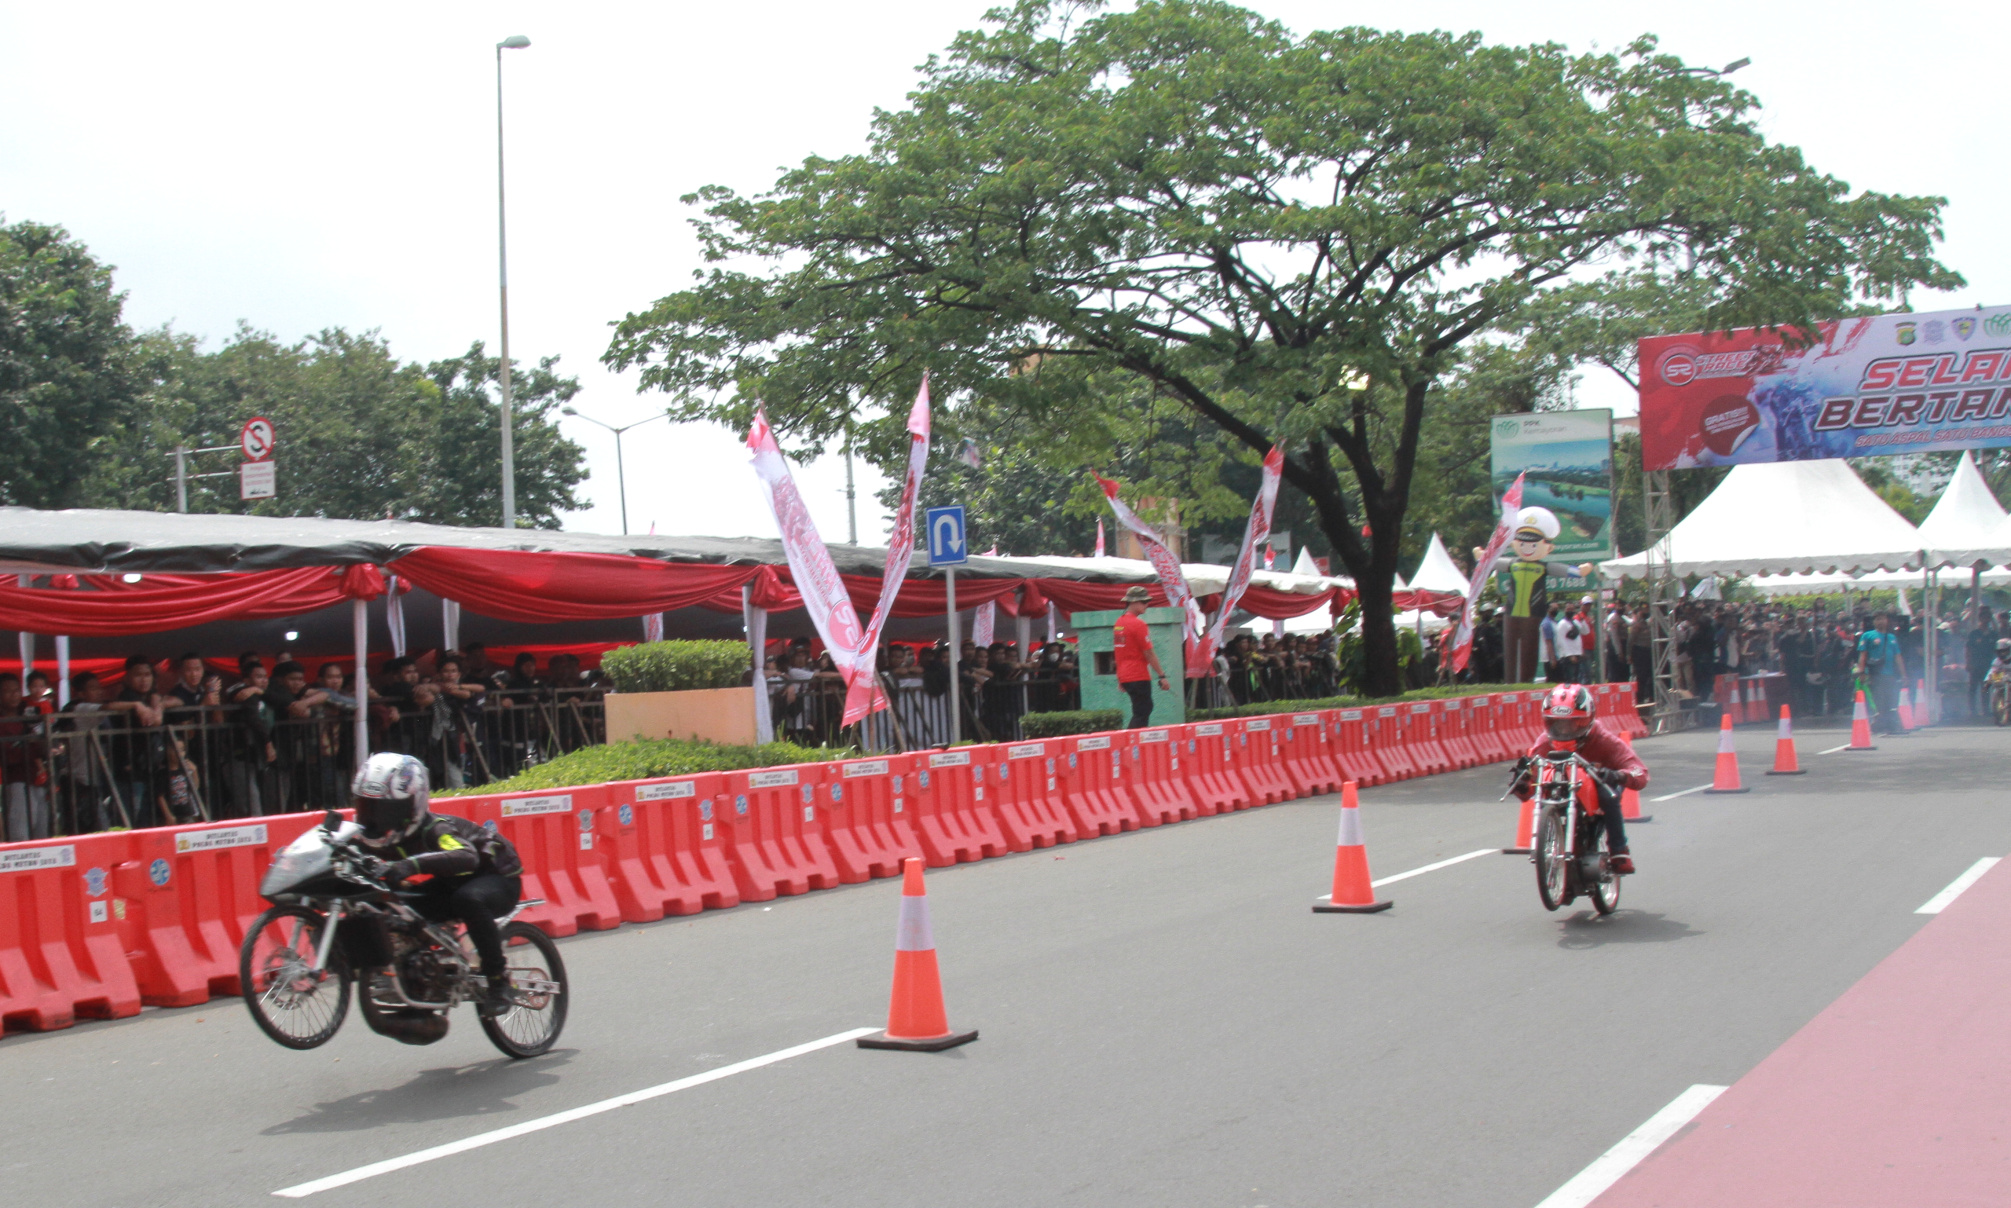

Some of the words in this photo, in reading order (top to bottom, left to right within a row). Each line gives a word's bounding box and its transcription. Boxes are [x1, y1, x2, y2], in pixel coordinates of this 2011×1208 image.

[1702, 358, 1749, 373] RACE
[1855, 433, 1891, 448] SATU
[1890, 430, 1932, 445] ASPAL
[1932, 427, 1970, 442] SATU
